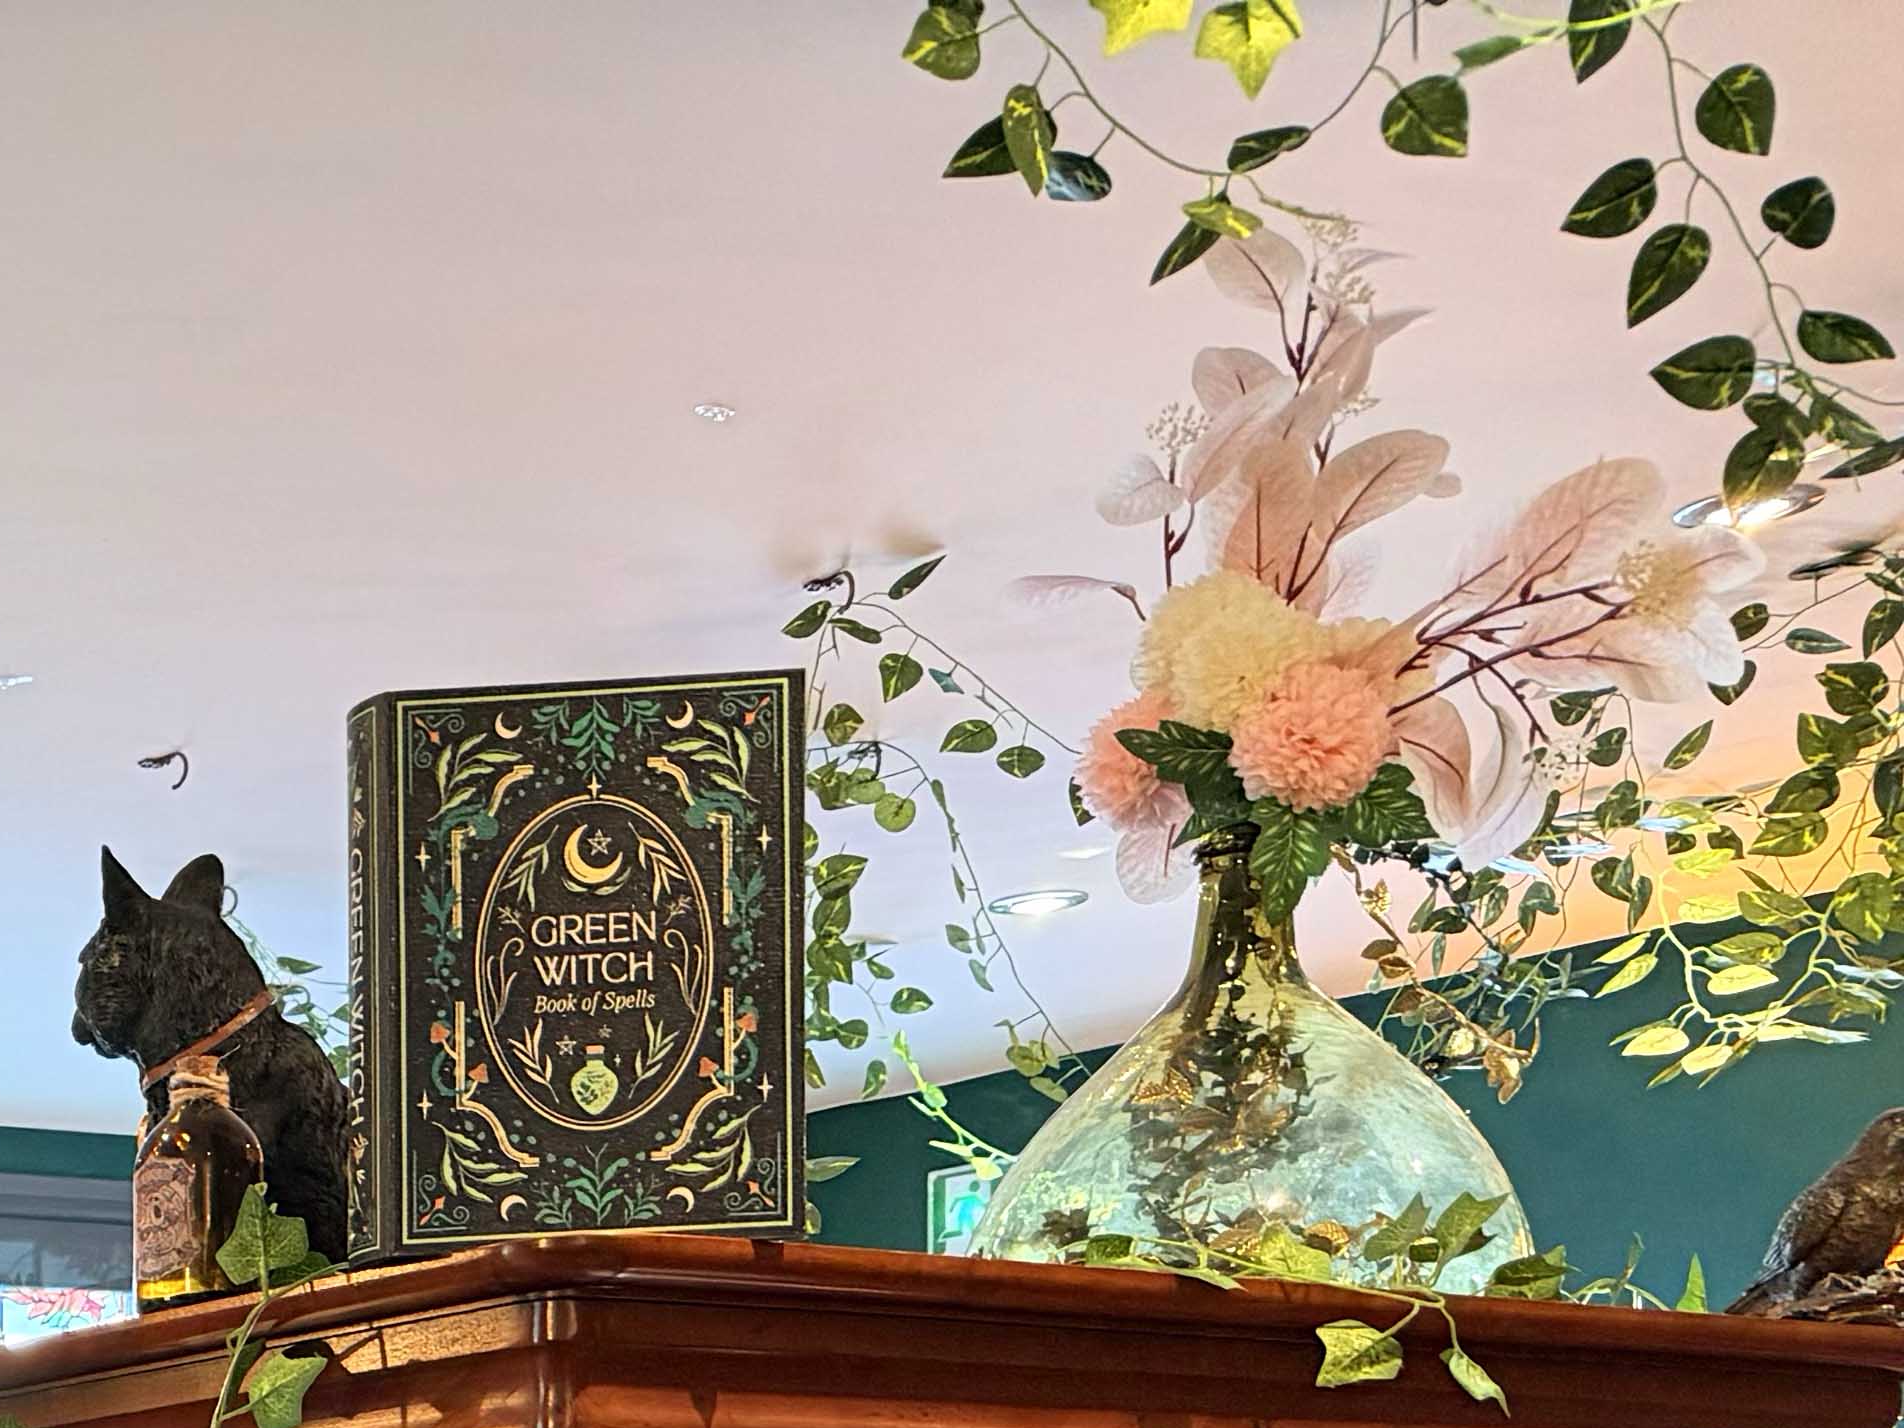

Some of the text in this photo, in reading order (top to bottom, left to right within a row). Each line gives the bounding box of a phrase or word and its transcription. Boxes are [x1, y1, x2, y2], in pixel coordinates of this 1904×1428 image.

[532, 910, 657, 947] GREEN
[533, 951, 653, 986] WITCH
[350, 848, 365, 1126] GREEN WITCH
[534, 989, 656, 1016] Book of Spells
